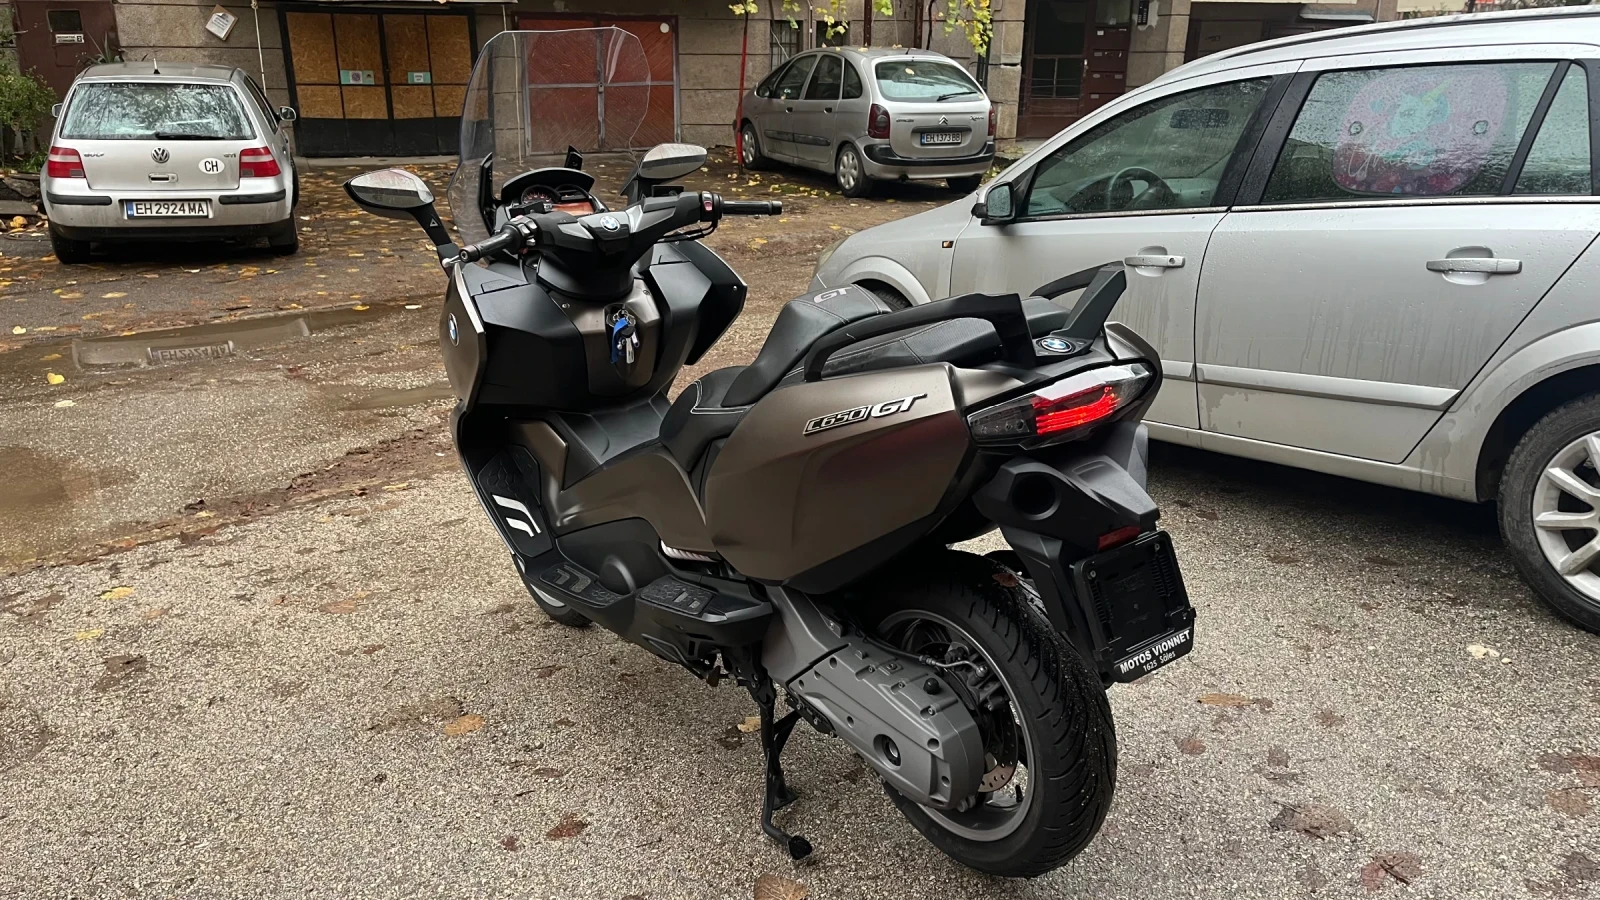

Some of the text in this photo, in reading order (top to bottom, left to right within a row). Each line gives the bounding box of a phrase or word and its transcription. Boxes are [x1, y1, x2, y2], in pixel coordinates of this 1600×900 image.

[204, 160, 219, 172] CH
[813, 286, 853, 304] GT
[804, 393, 928, 433] C650 GT
[1119, 629, 1191, 674] MOTOS VIONNET
[1142, 659, 1158, 673] 1625
